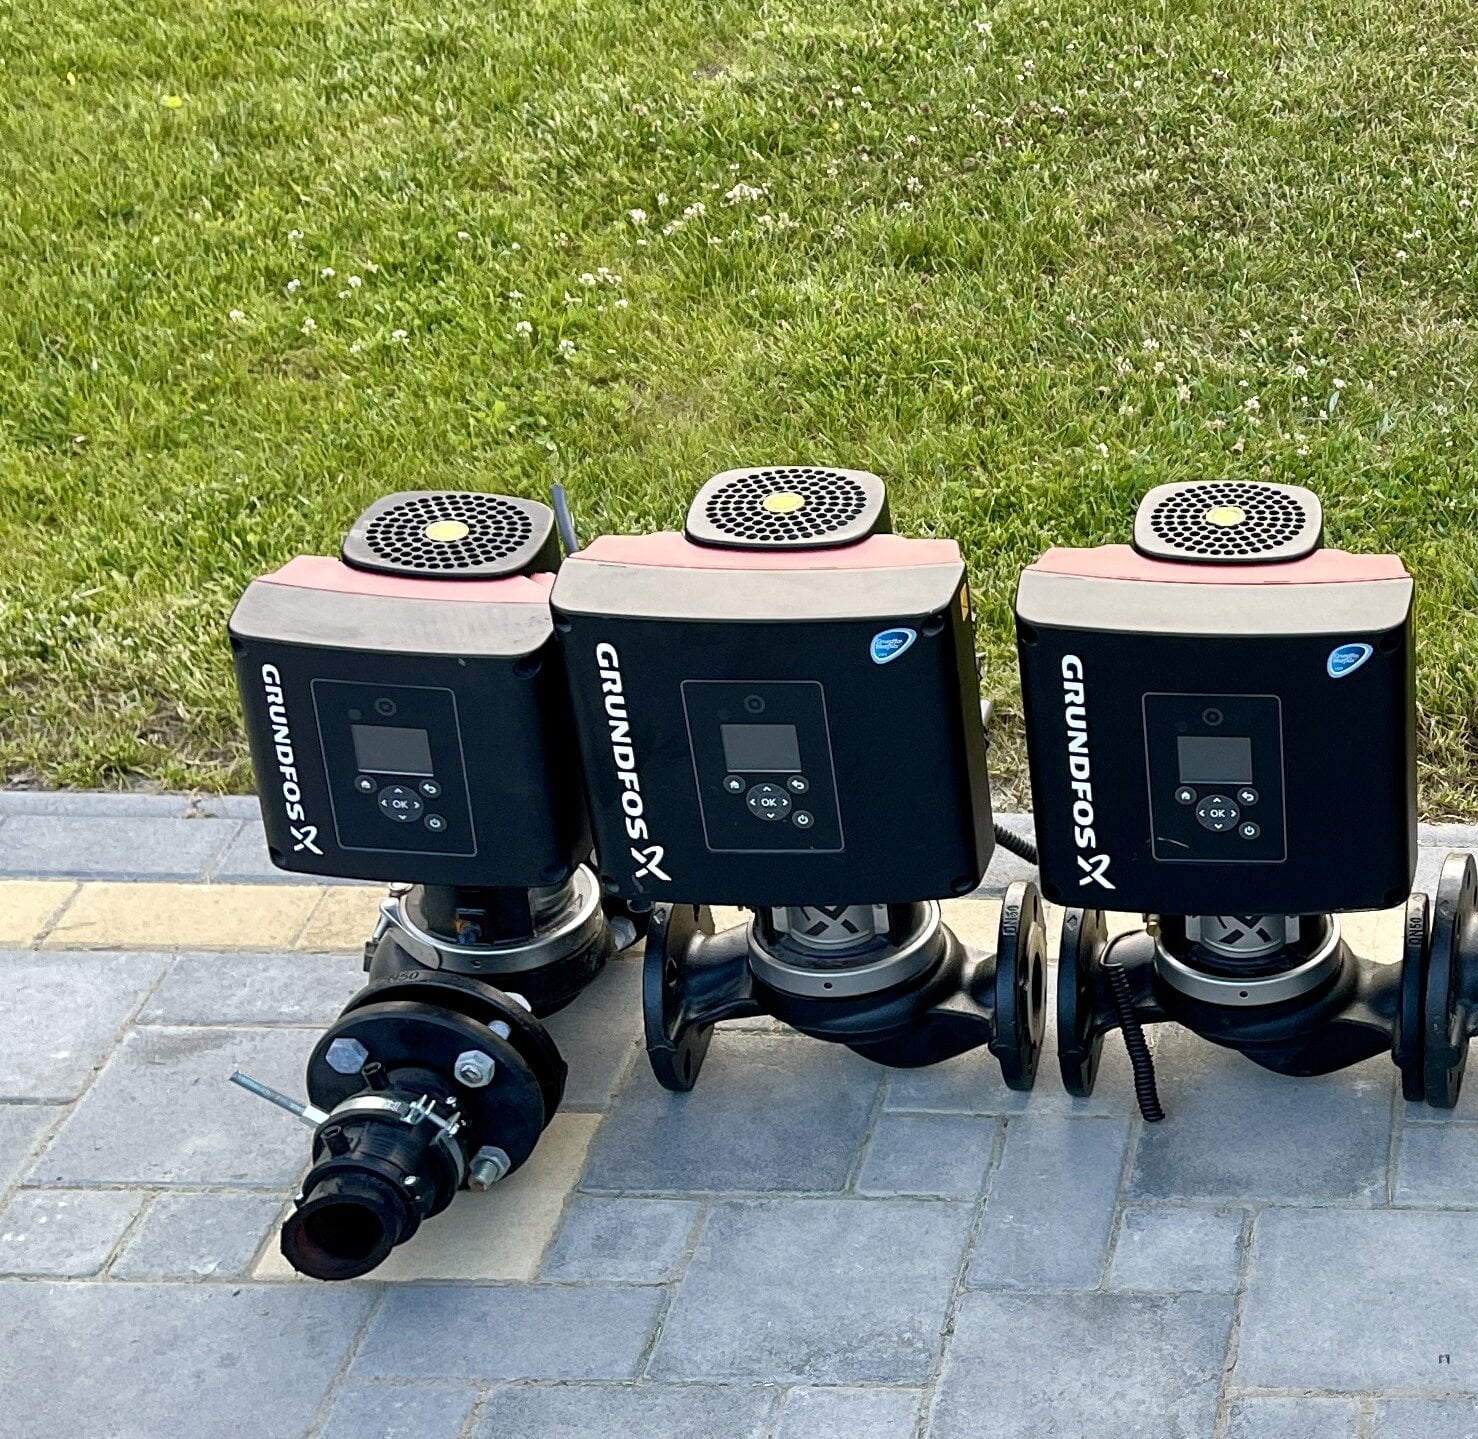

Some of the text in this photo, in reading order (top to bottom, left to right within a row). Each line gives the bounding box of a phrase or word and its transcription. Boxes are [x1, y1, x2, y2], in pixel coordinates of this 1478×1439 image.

[262, 663, 305, 821] GRUNDFOS
[597, 642, 649, 840] GRUNDFOS
[1061, 654, 1096, 849] GRUNDFOS
[392, 799, 409, 809] OK
[761, 798, 777, 807] OK
[1209, 809, 1226, 818] OK
[1408, 917, 1423, 947] DN50
